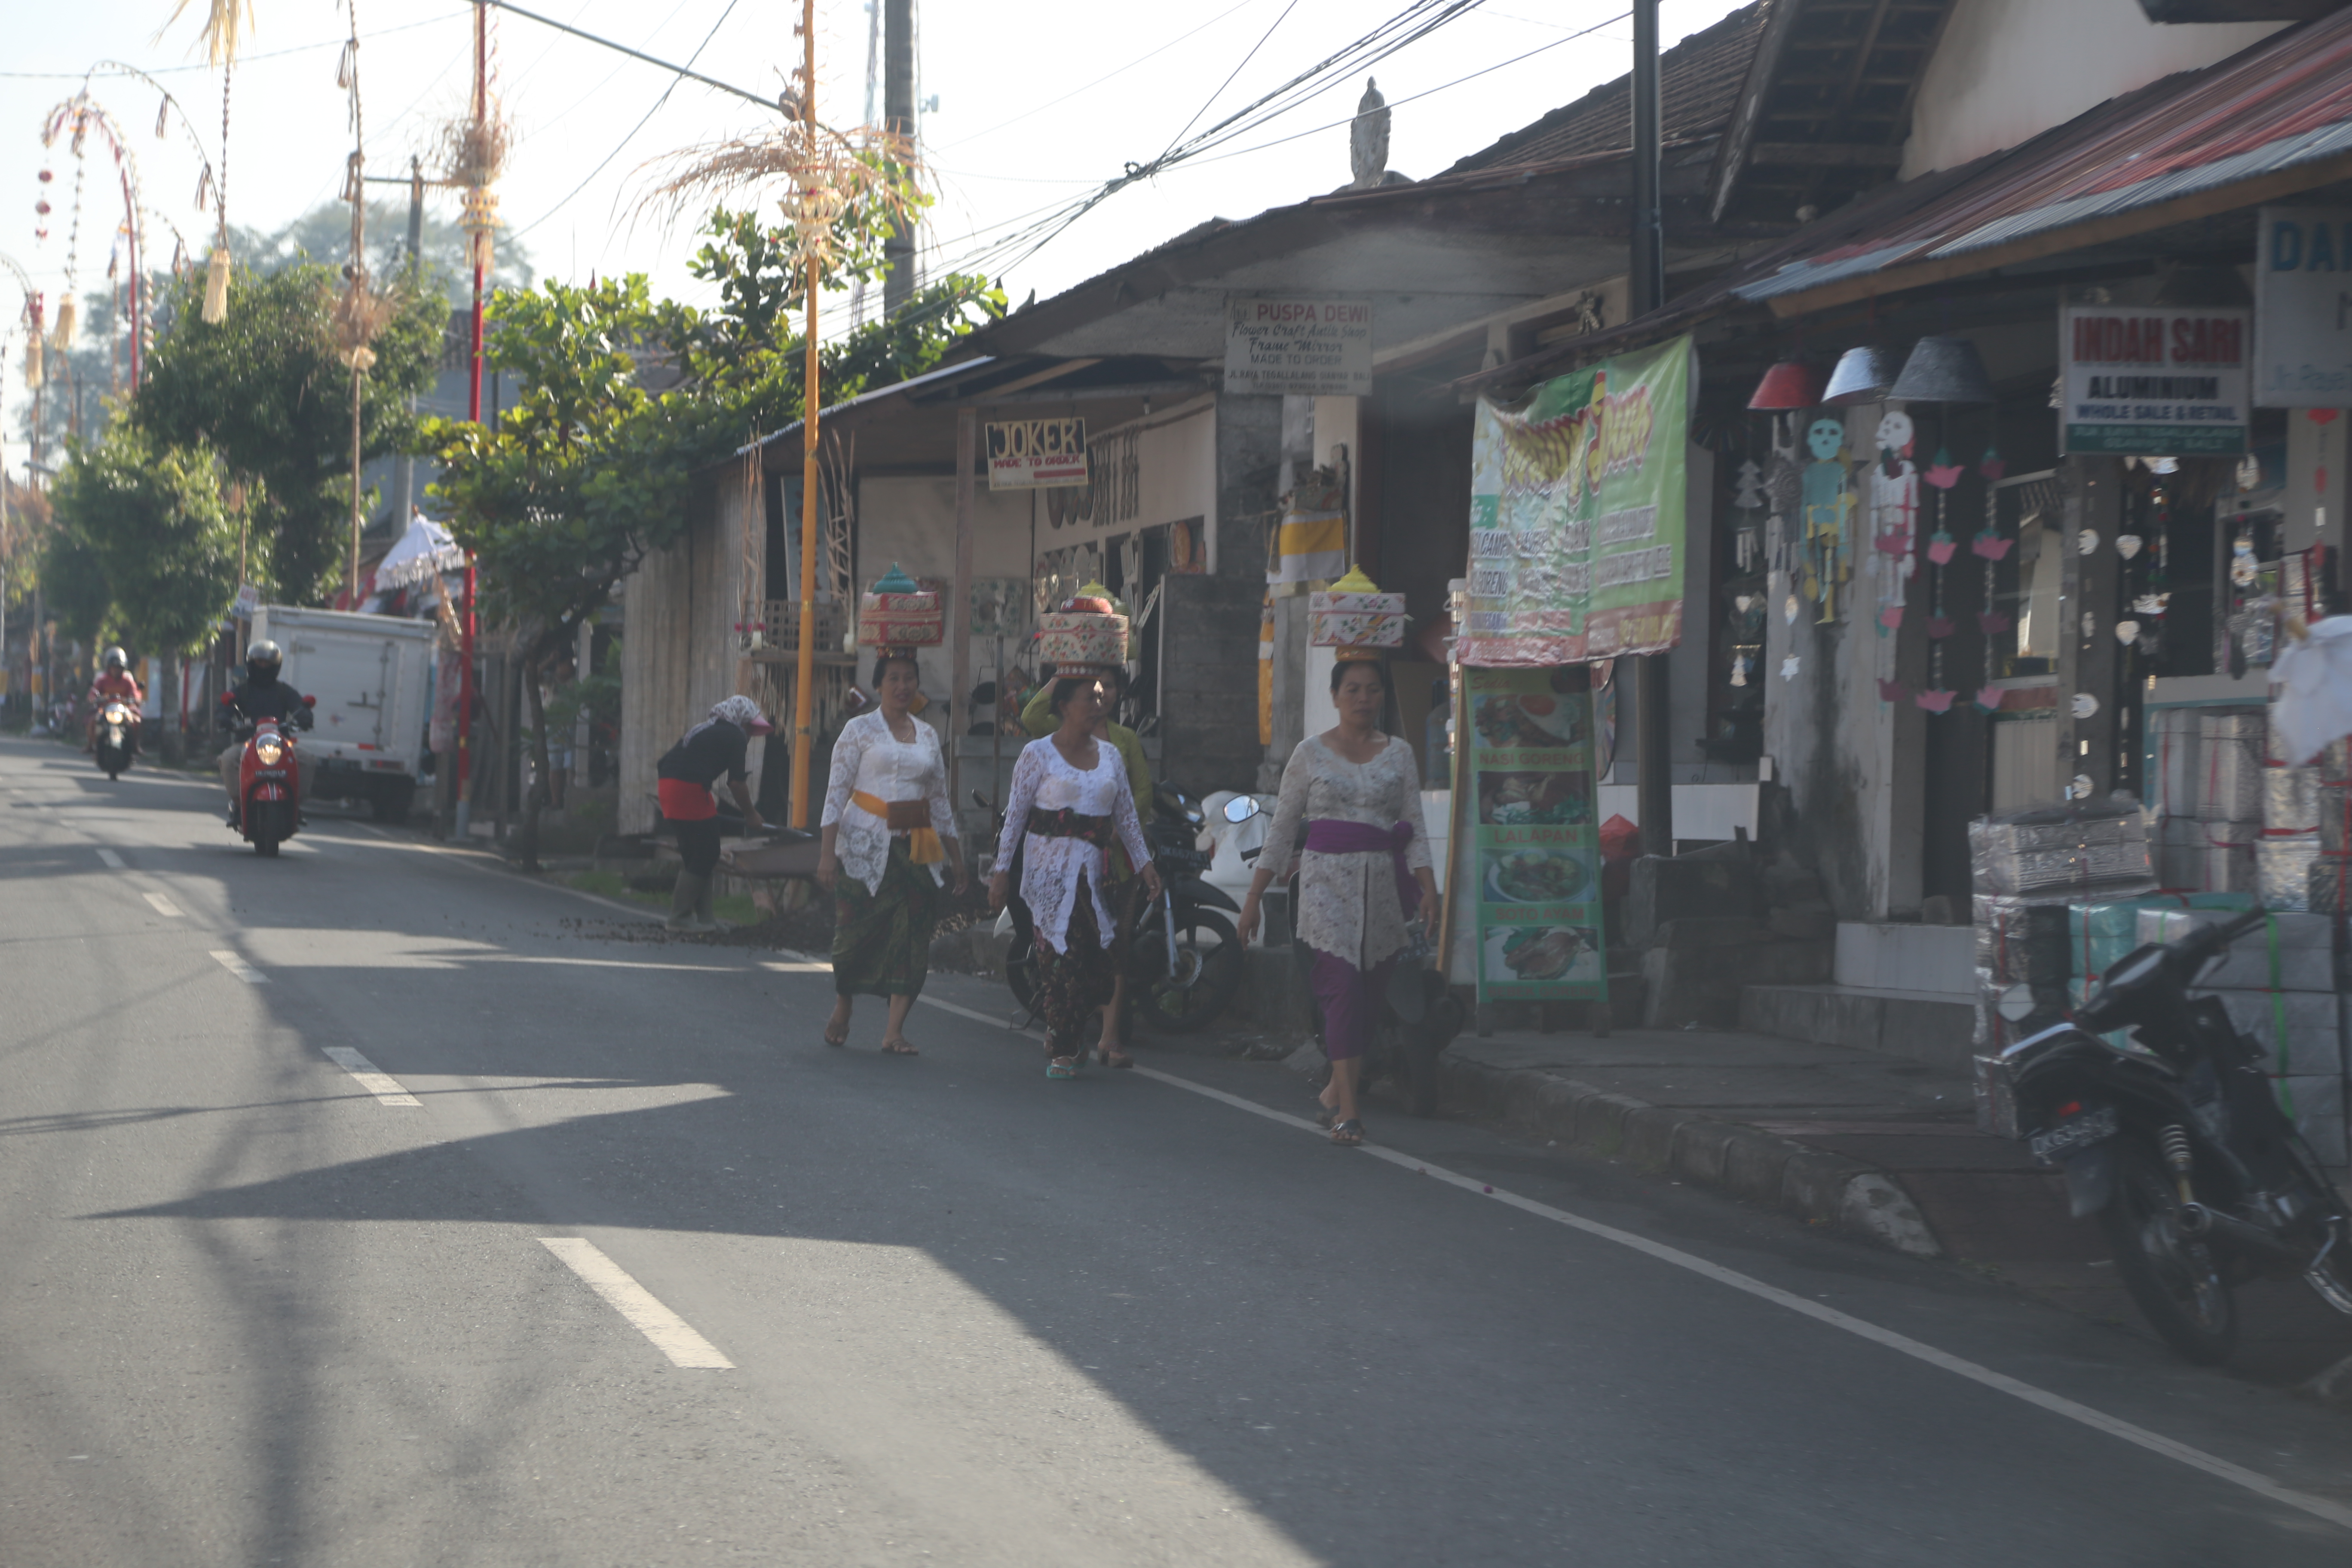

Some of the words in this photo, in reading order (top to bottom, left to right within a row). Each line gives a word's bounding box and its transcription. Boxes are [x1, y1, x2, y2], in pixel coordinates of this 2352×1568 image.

[1257, 304, 1316, 322] PUSPA
[1325, 305, 1368, 322] DEWI
[1232, 320, 1269, 338] Flower
[1273, 323, 1305, 339] Craft
[1341, 325, 1366, 340] Shop
[1249, 337, 1289, 353] Frame
[1294, 340, 1342, 352] Mirror
[2073, 317, 2162, 362] INDAH
[2171, 317, 2242, 362] SARI
[1251, 354, 1282, 364] MADE
[1287, 354, 1301, 364] TO
[1305, 354, 1341, 365] ORDER
[1262, 370, 1316, 380] TEGALLALANG
[1320, 371, 1348, 380] GIANYAR
[1354, 372, 1369, 381] BALI
[2076, 404, 2130, 419] WHOLE
[2135, 405, 2171, 419] SALE
[2190, 406, 2239, 420] RETAIL
[993, 418, 1079, 458] JOKER
[994, 459, 1021, 469] MADE
[1027, 457, 1042, 466] TO
[1045, 453, 1079, 466] ORDER
[1470, 676, 1511, 690] Sedia
[1479, 753, 1513, 765] NASI
[1519, 753, 1584, 765] GORENG
[1494, 830, 1577, 843] LALAPAN
[1496, 908, 1538, 920] SOTO
[1542, 908, 1584, 920] AYAM
[1487, 986, 1534, 997] BEBEK
[1540, 986, 1599, 997] GORENG
